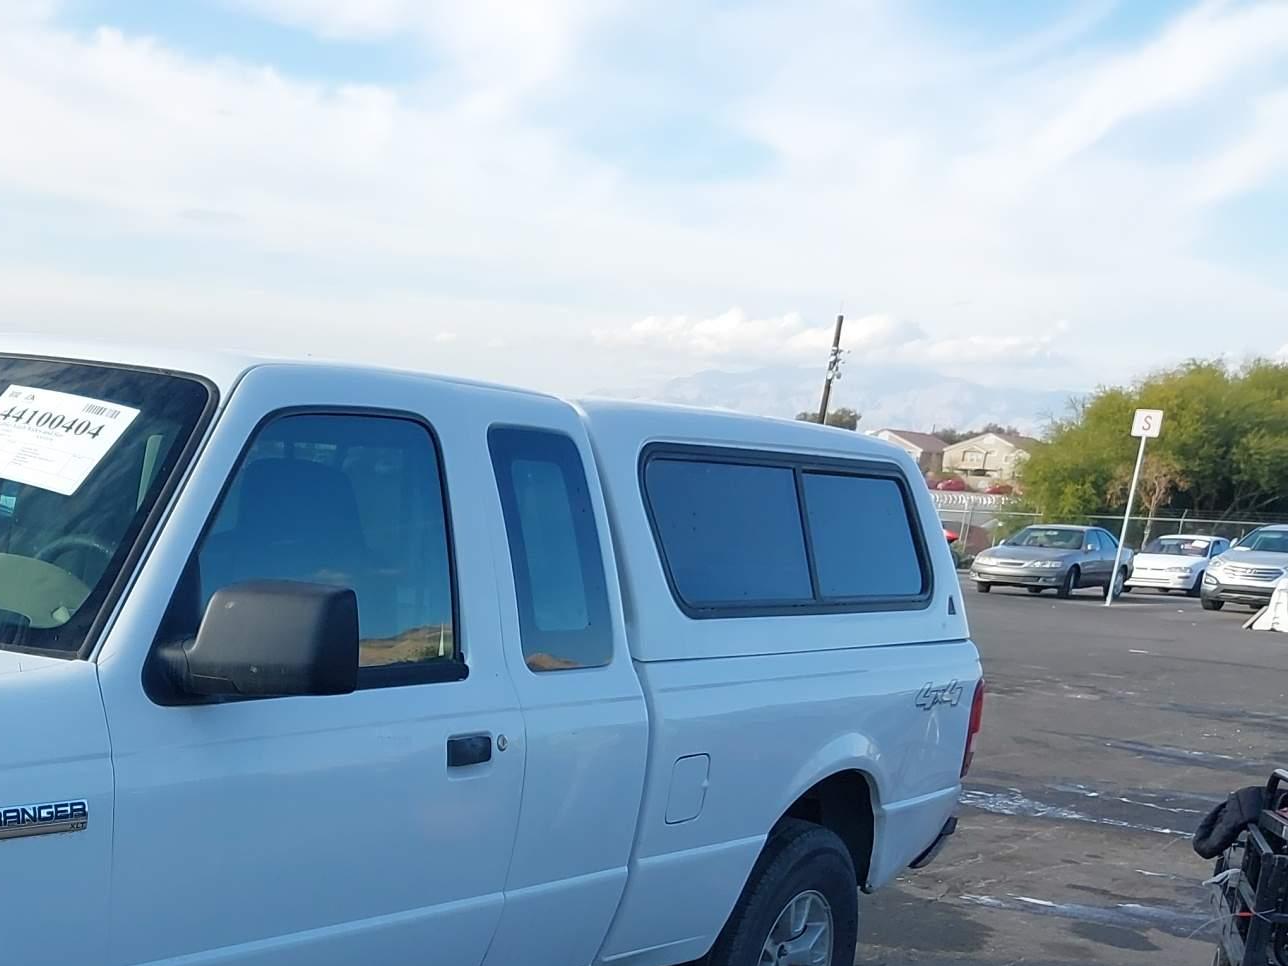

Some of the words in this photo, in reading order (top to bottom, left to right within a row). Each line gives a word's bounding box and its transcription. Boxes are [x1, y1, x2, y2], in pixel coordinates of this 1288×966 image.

[0, 405, 106, 440] 44100404
[1142, 415, 1153, 431] S
[914, 679, 964, 711] 4x4
